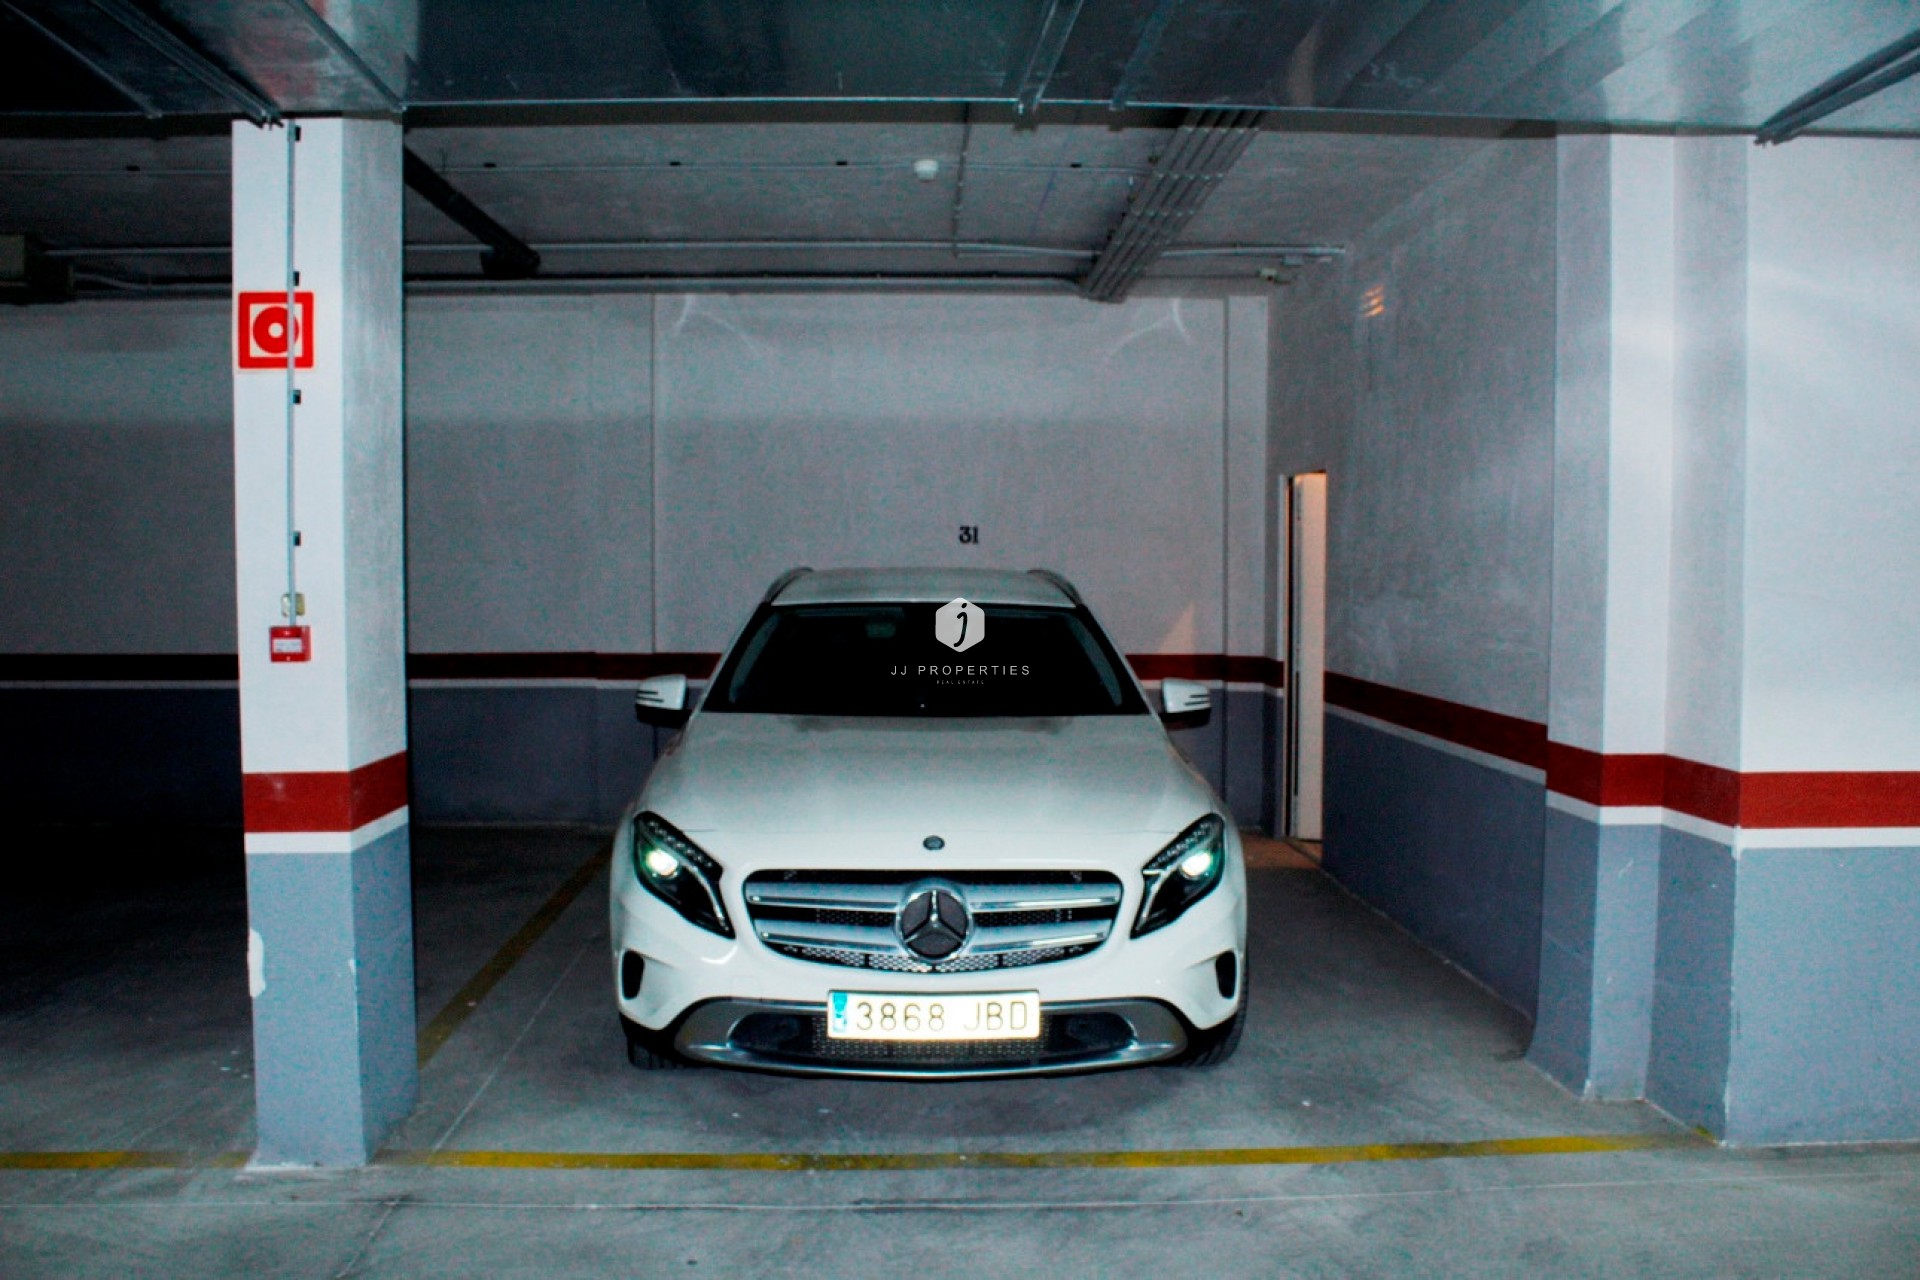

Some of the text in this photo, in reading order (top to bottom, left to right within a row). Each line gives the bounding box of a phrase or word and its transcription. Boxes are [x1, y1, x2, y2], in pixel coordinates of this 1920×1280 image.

[959, 525, 979, 545] 31
[856, 1001, 1028, 1032] 3868 JBD
